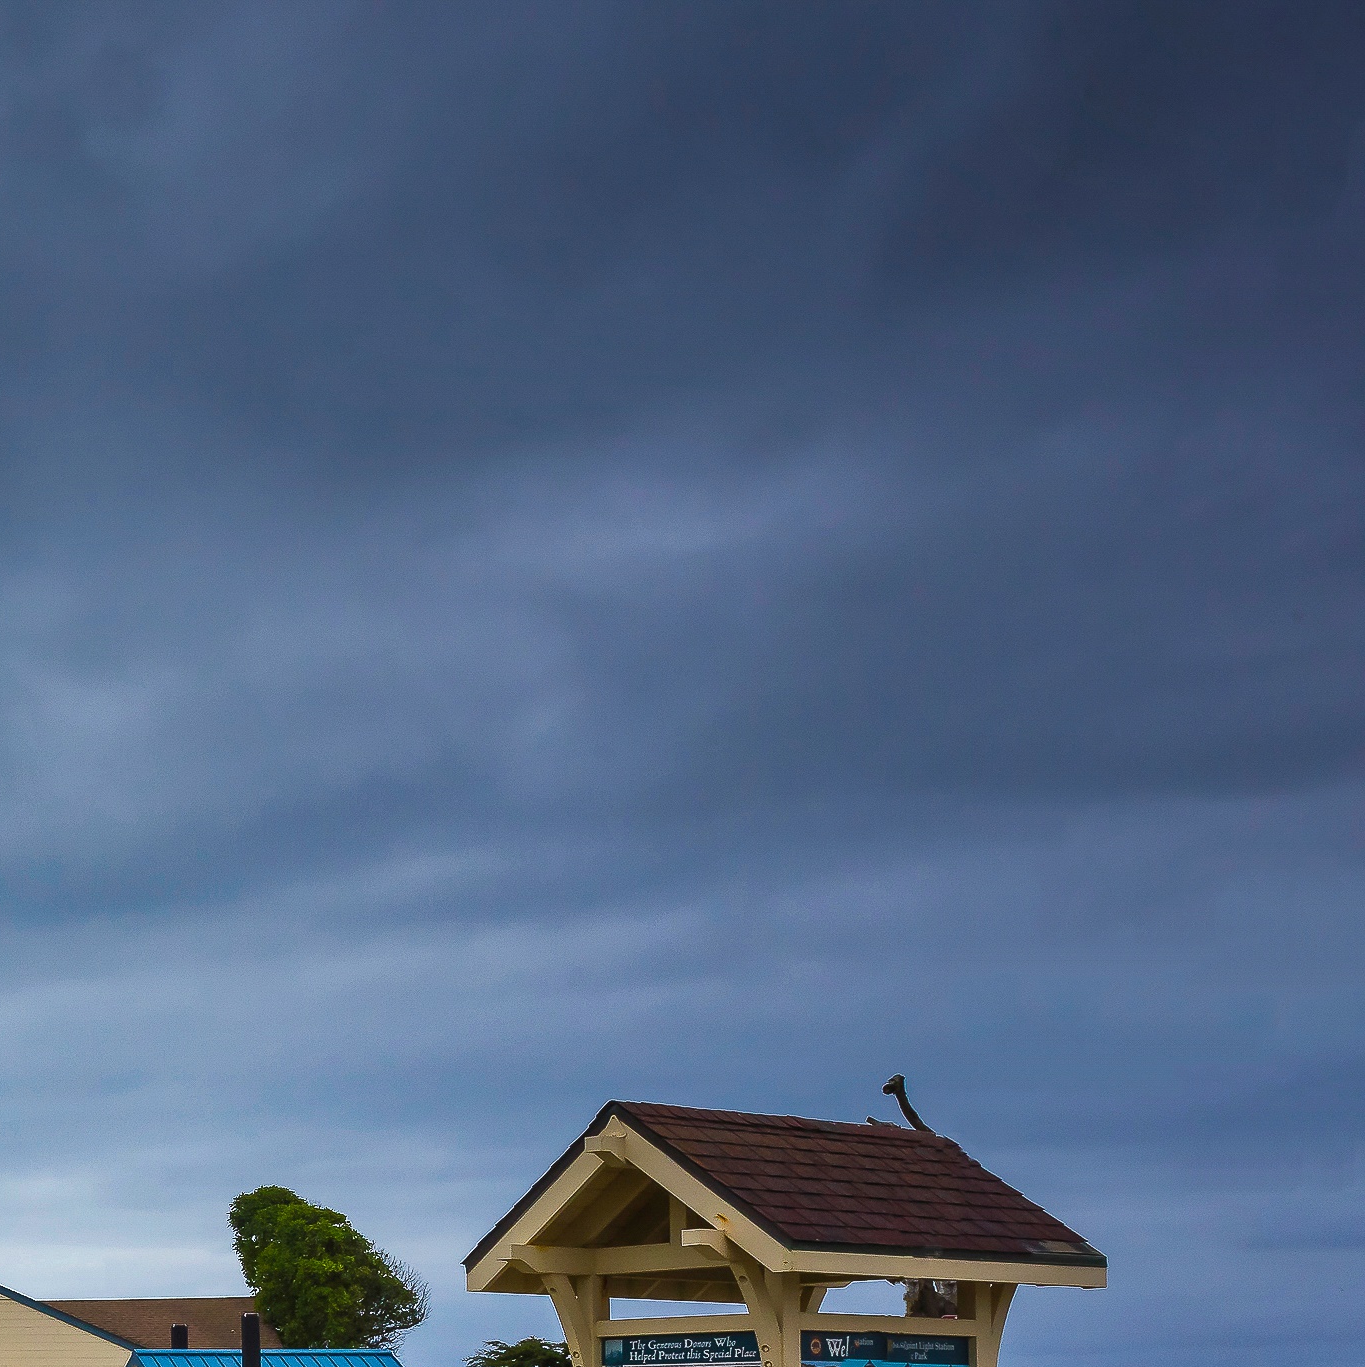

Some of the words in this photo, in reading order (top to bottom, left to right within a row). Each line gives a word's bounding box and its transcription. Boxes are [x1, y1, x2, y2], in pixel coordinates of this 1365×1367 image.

[630, 1340, 645, 1350] The
[648, 1339, 682, 1350] Generous
[684, 1338, 712, 1349] Donors
[714, 1336, 736, 1347] Who
[629, 1349, 656, 1363] Helped
[658, 1349, 685, 1360] Protect
[686, 1347, 701, 1360] this
[703, 1347, 732, 1361] Special
[735, 1346, 757, 1358] Place
